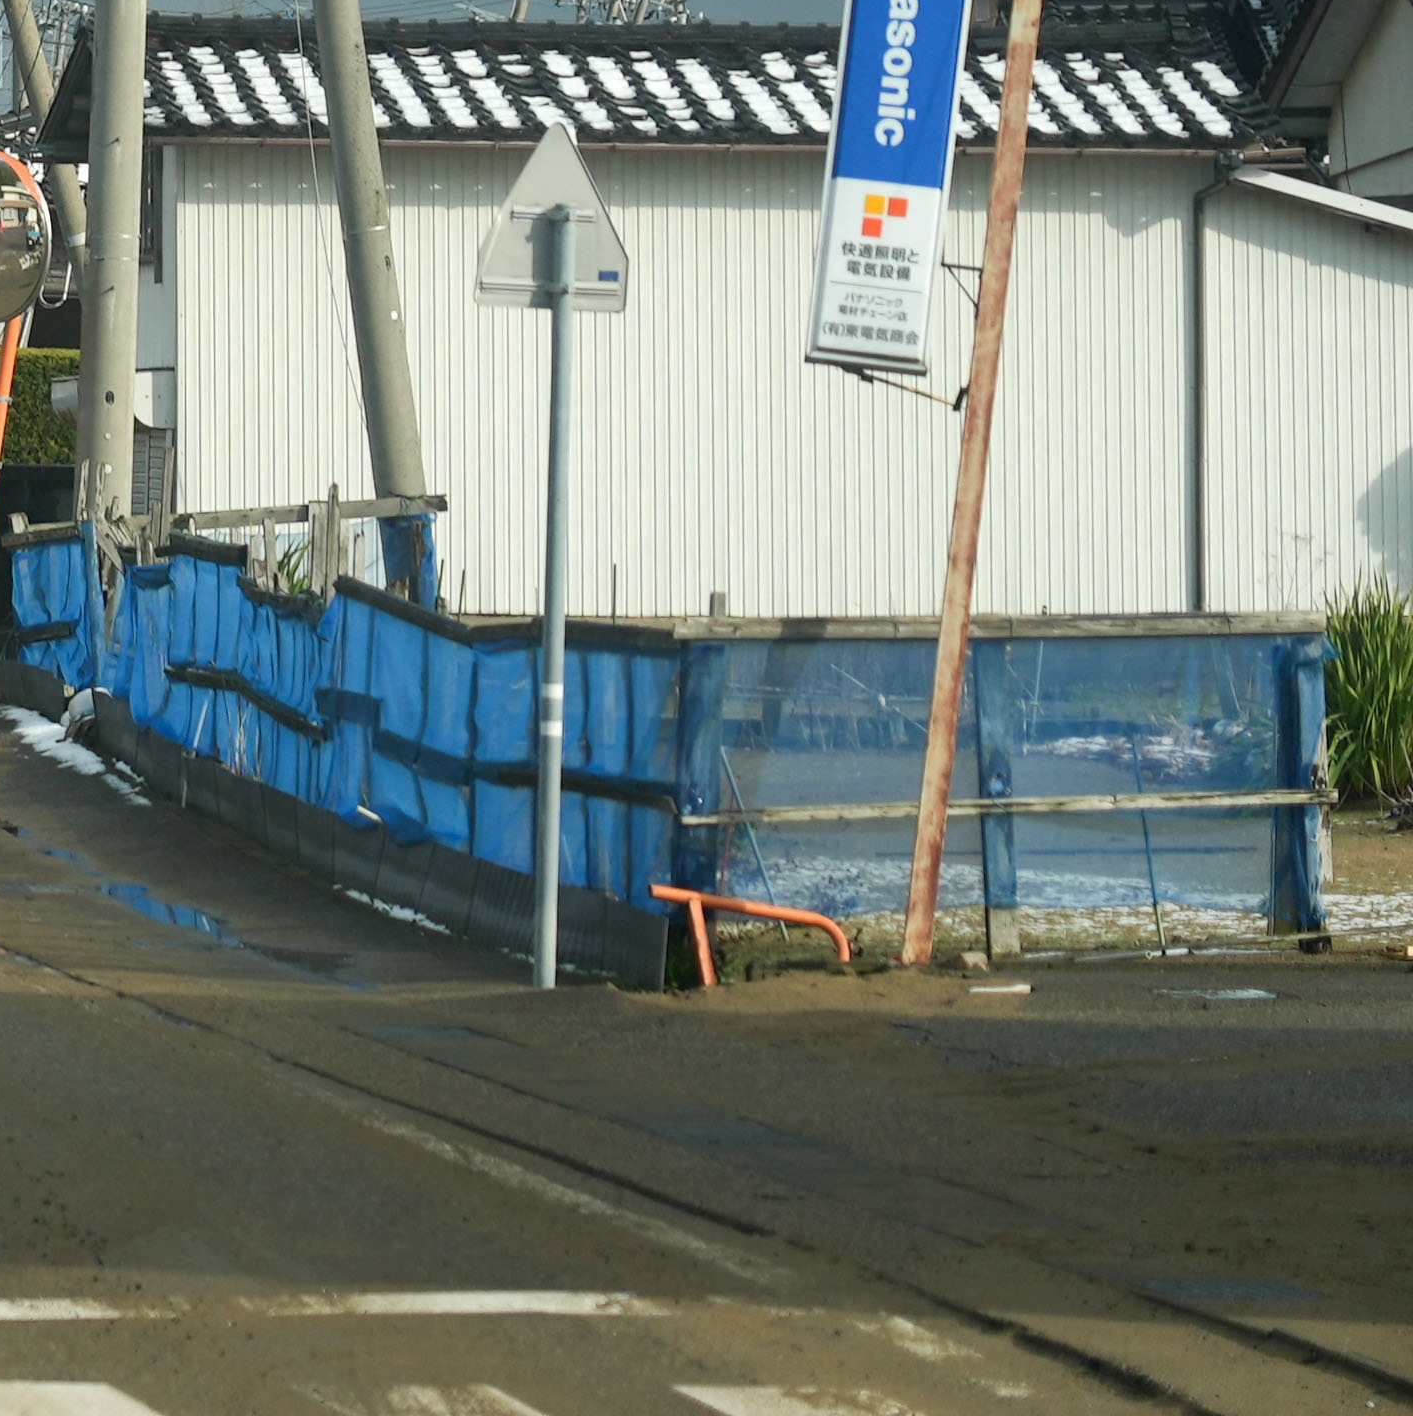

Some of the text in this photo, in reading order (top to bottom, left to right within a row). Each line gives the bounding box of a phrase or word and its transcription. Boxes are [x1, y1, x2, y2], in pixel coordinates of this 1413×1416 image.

[842, 241, 920, 264] 快適照明と
[847, 261, 911, 281] 電気設備
